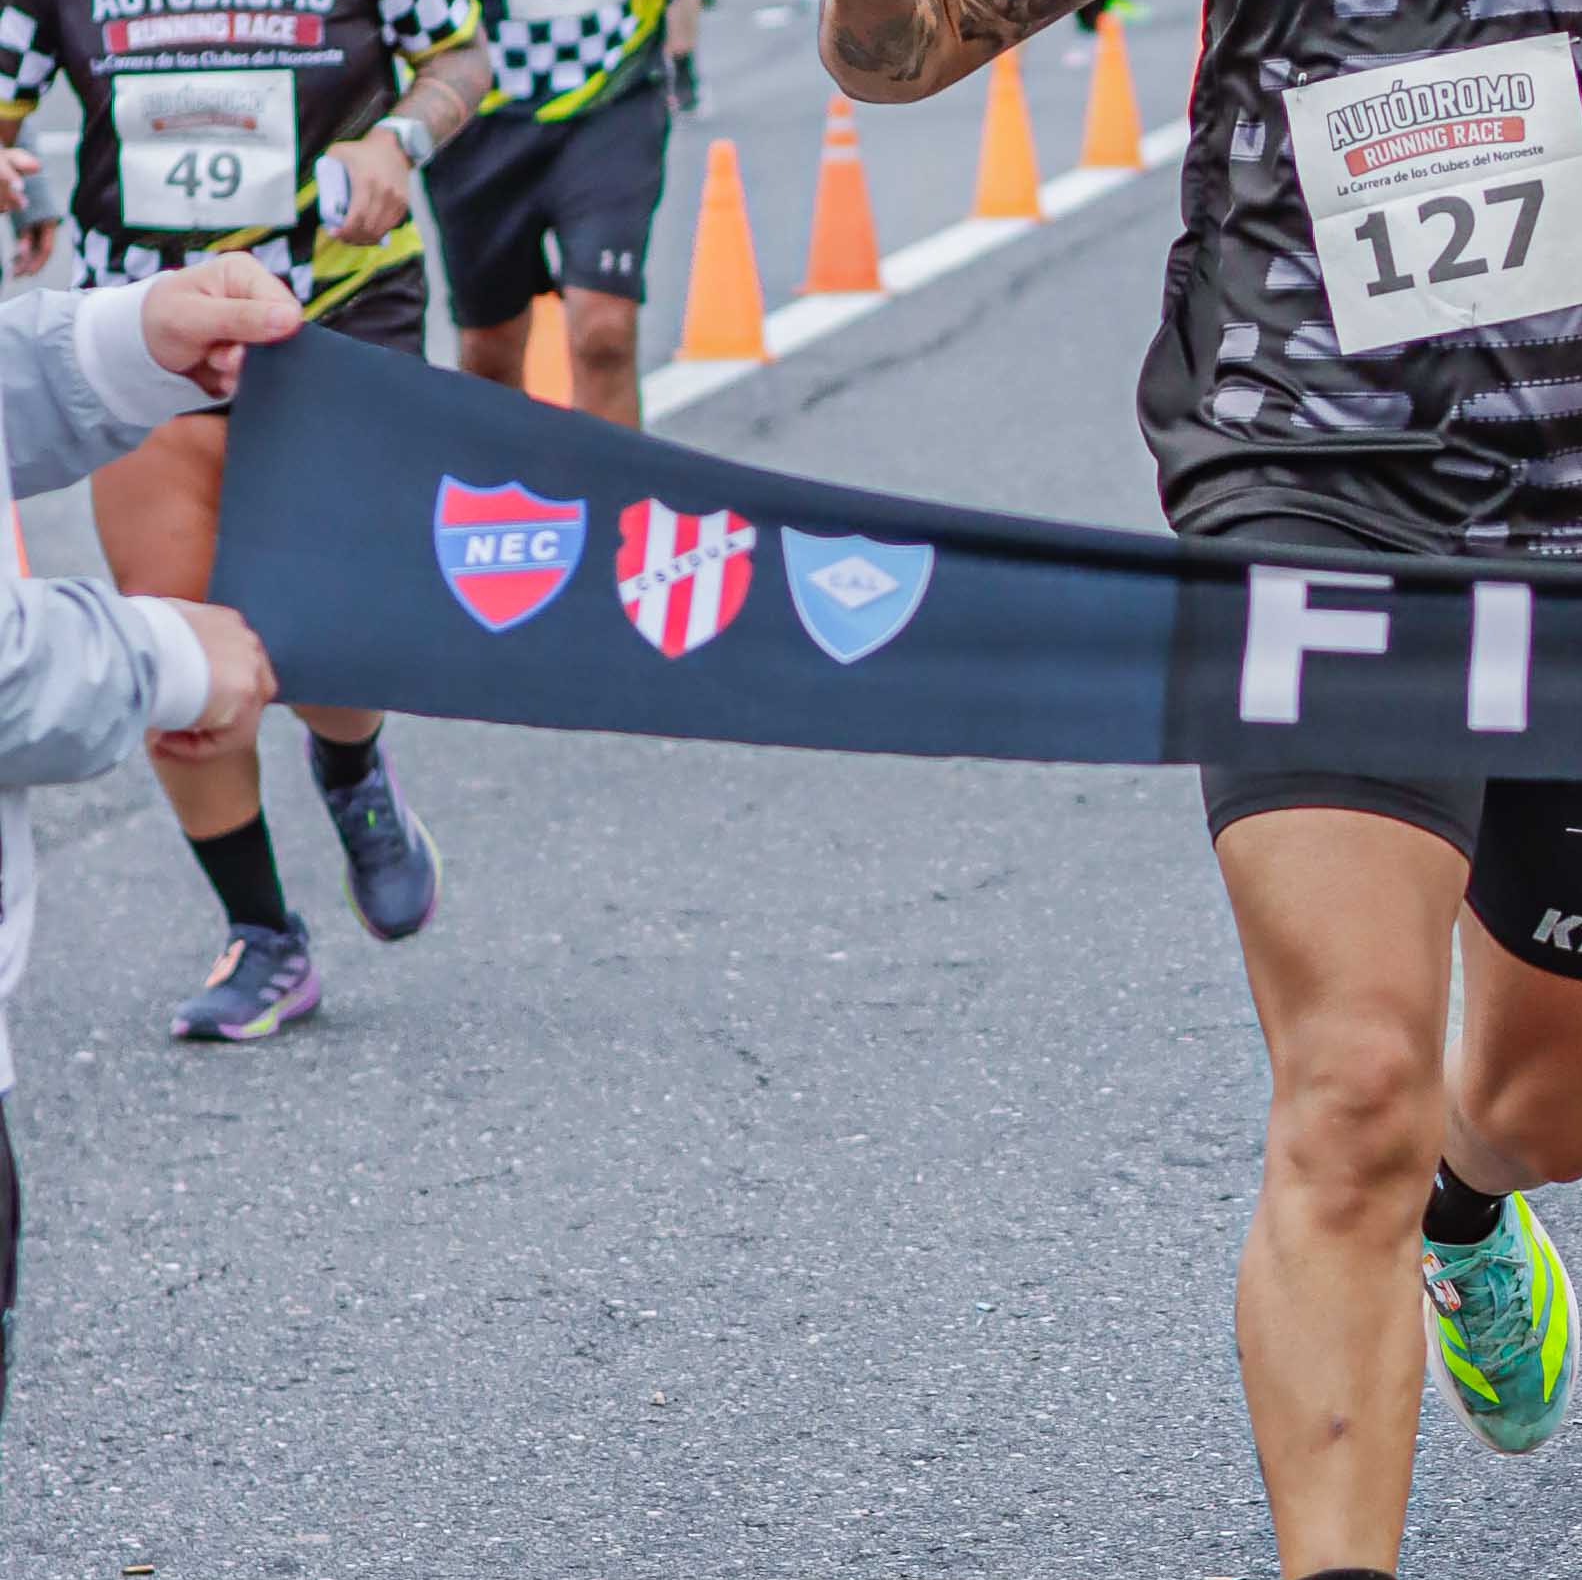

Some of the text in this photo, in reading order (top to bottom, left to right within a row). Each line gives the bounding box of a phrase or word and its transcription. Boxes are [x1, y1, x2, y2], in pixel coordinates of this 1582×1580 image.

[234, 12, 297, 46] RACE
[1326, 72, 1535, 152] AUTÓDROMO
[1363, 120, 1505, 170] RUNNING RACE
[163, 150, 244, 200] 49
[1336, 144, 1545, 197] La Carrera de los Clubes del Noroeste
[1354, 178, 1546, 298] 127
[463, 528, 562, 566] NEC
